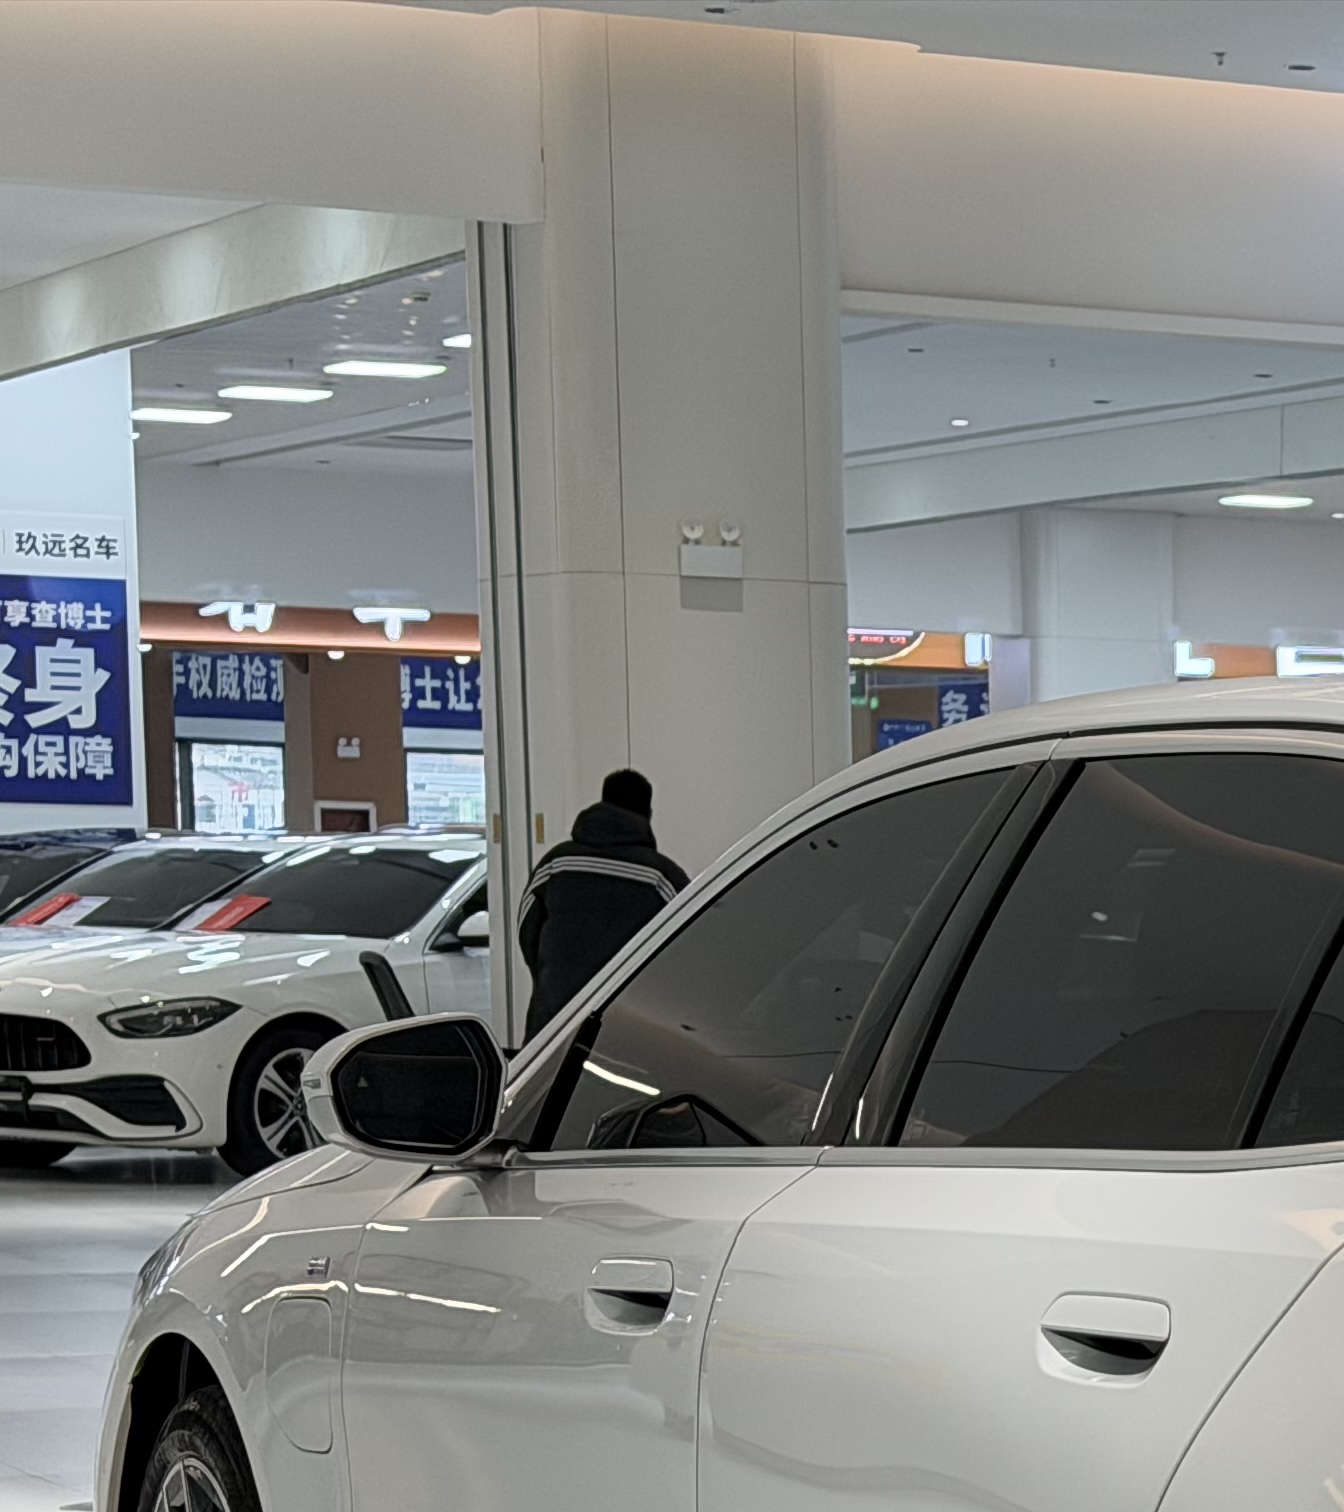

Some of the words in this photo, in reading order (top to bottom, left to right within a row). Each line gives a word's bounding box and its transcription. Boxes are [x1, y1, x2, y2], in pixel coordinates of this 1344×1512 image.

[14, 531, 119, 560] 玖远名车
[0, 599, 112, 630] 享查博士
